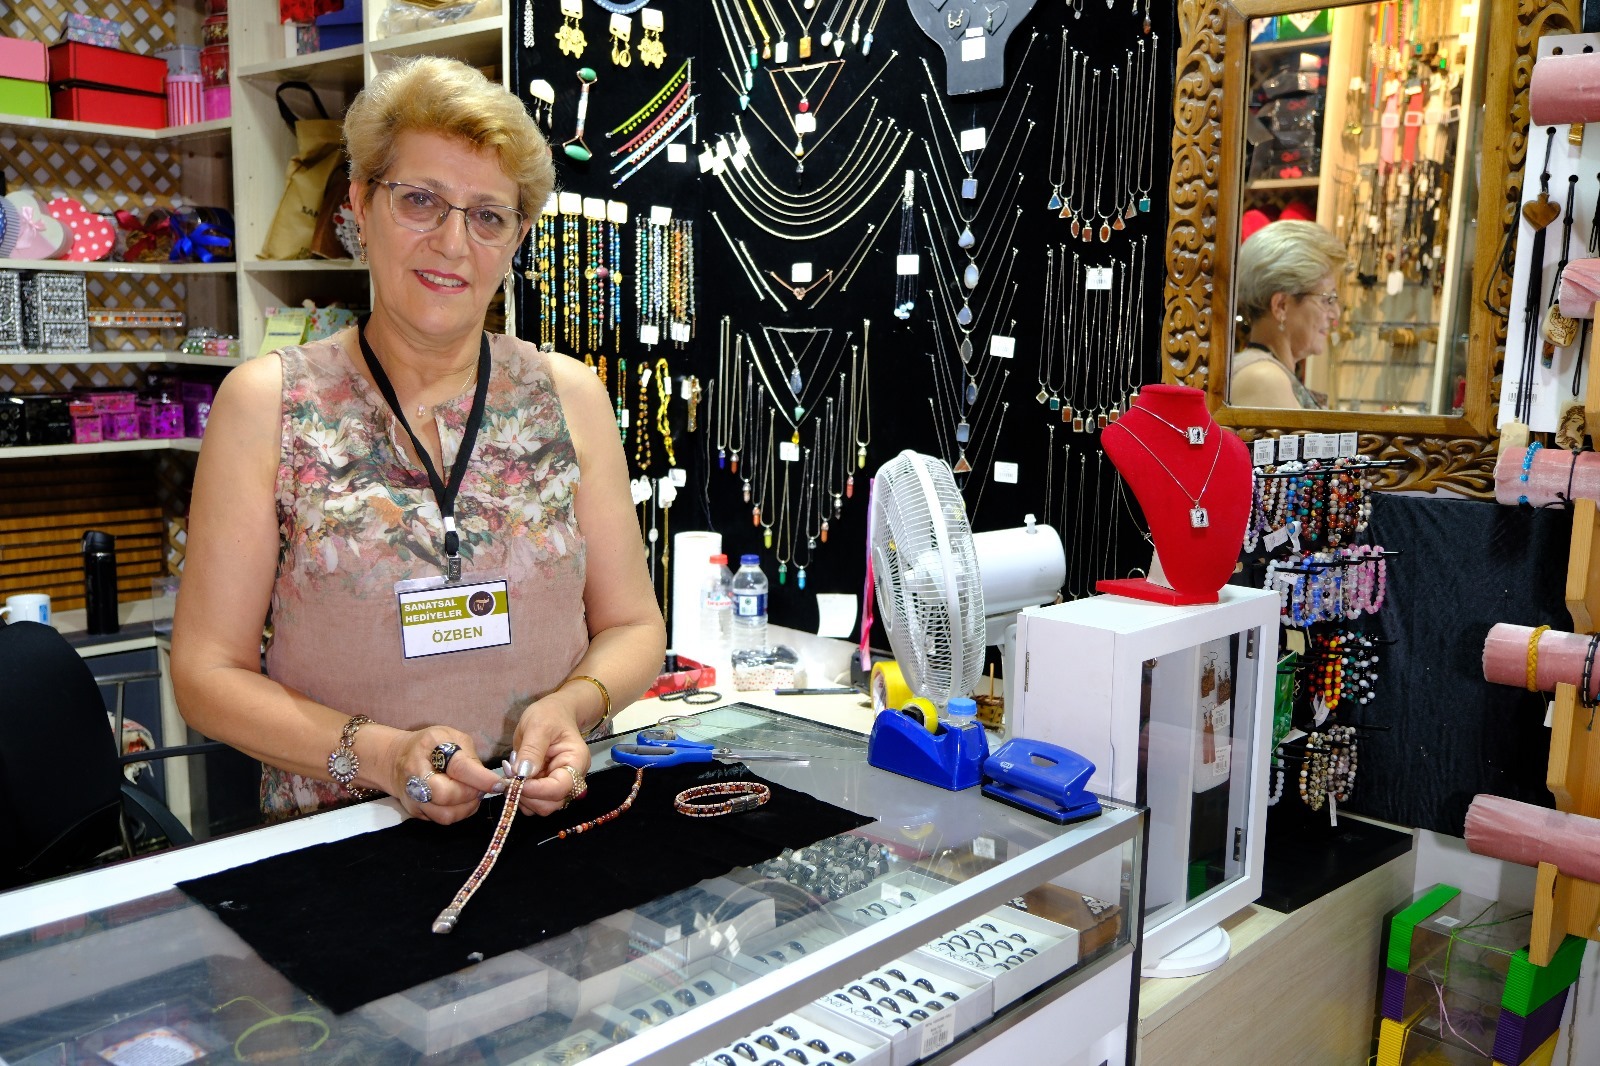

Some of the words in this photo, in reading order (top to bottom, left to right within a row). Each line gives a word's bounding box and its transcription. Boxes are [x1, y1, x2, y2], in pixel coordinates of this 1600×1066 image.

[404, 599, 457, 611] SANATSAL
[405, 610, 462, 623] HEDİYELER
[432, 626, 482, 643] ÖZBEN
[844, 1007, 893, 1028] FASHION
